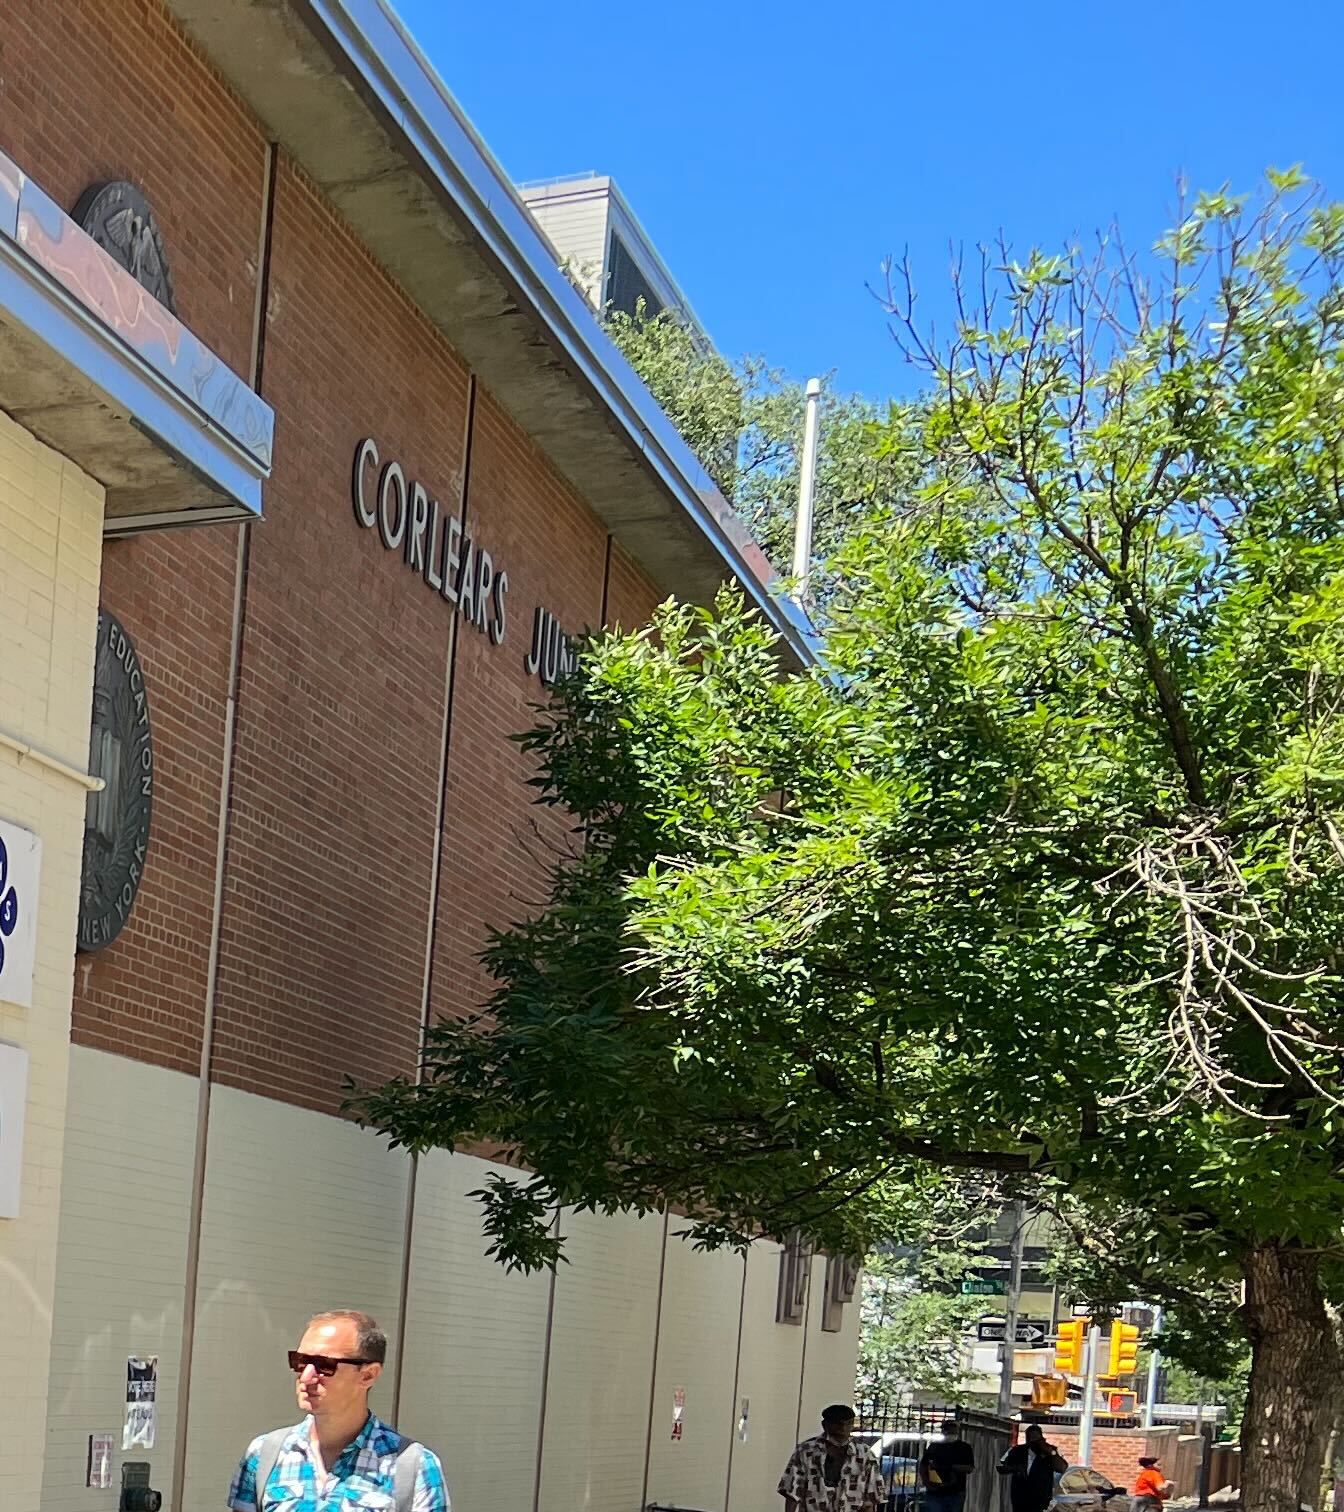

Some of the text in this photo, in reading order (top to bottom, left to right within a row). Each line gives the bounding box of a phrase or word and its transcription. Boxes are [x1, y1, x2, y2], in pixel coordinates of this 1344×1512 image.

[353, 438, 508, 645] CORLEARS
[109, 624, 152, 796] EDUCATION
[81, 837, 146, 944] NEW YORK
